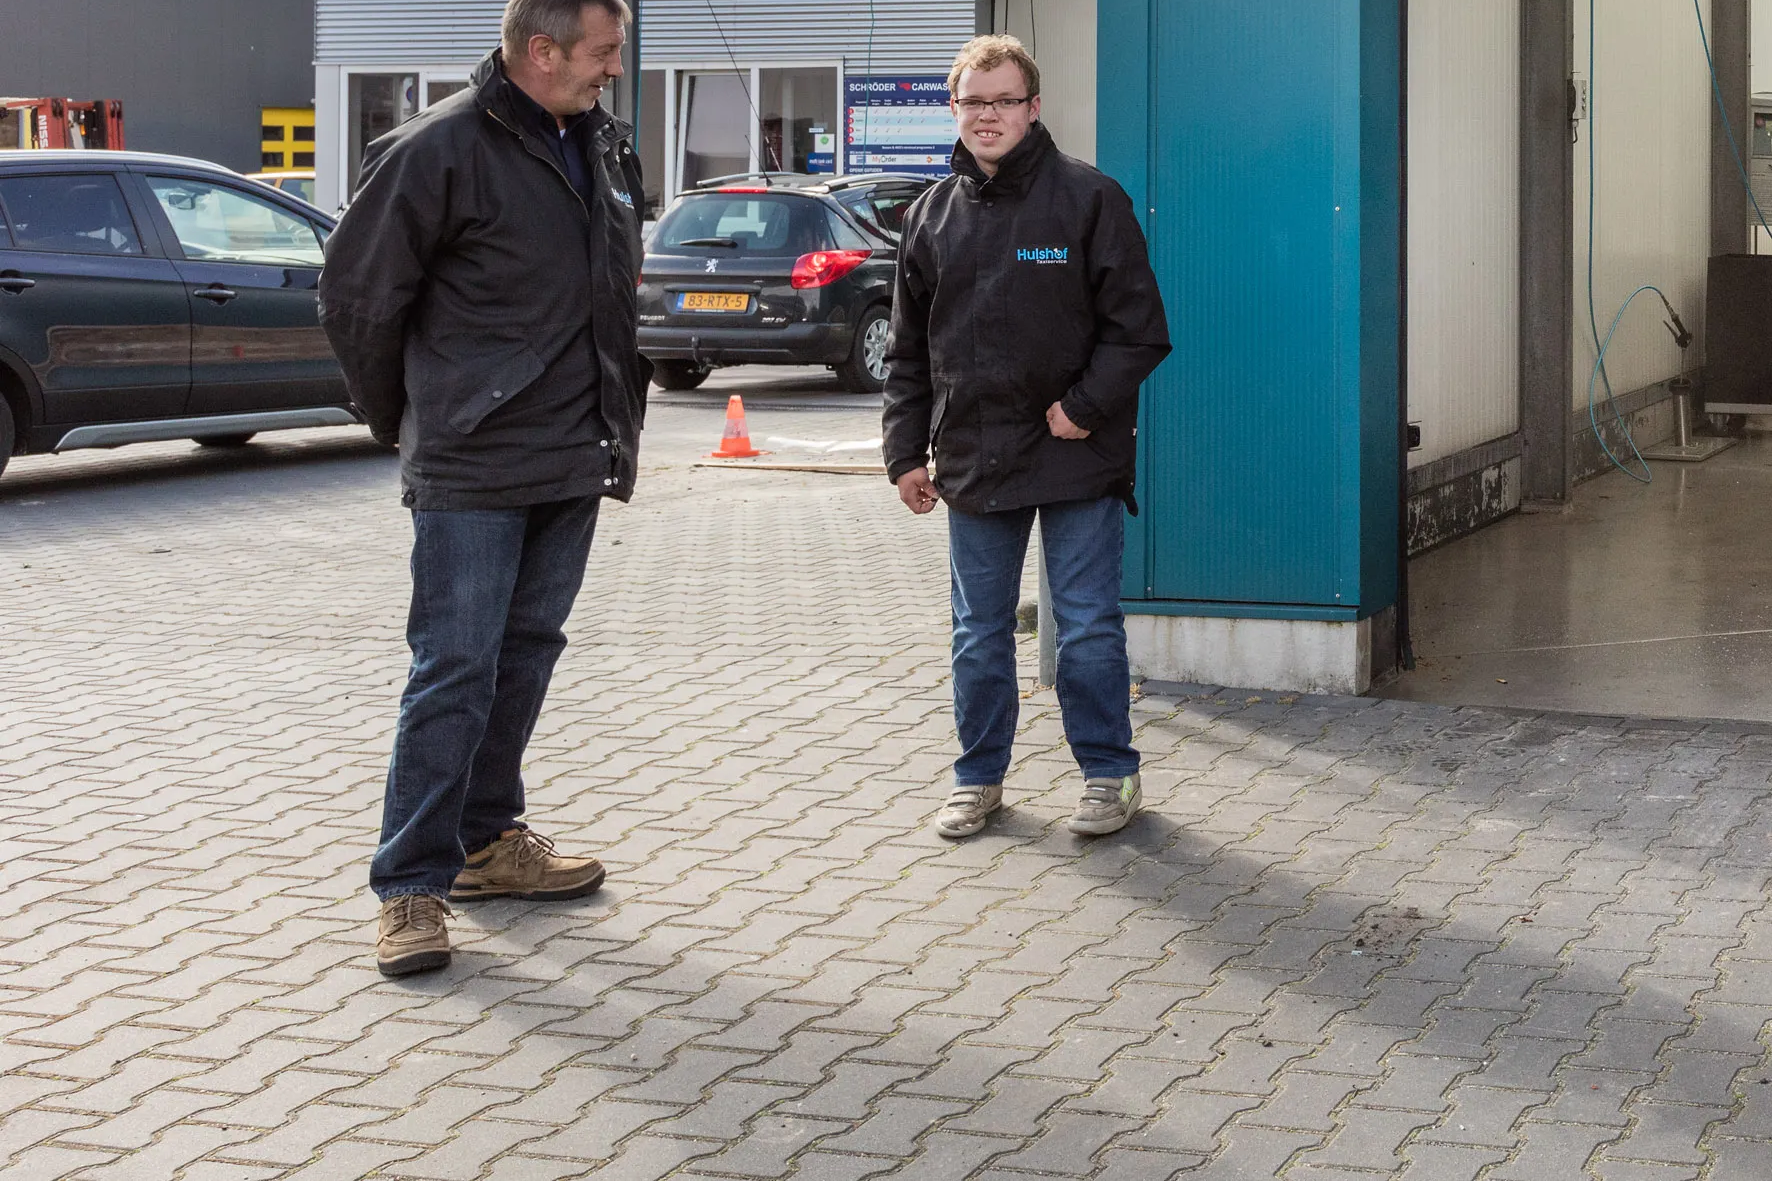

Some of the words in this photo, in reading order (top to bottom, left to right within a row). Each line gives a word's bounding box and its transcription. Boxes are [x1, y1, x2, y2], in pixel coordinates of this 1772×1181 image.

[849, 82, 896, 91] SCHRÖDER
[911, 82, 951, 91] CARWAS
[1017, 247, 1068, 261] Hulshof
[688, 294, 743, 308] 83-RTX-5
